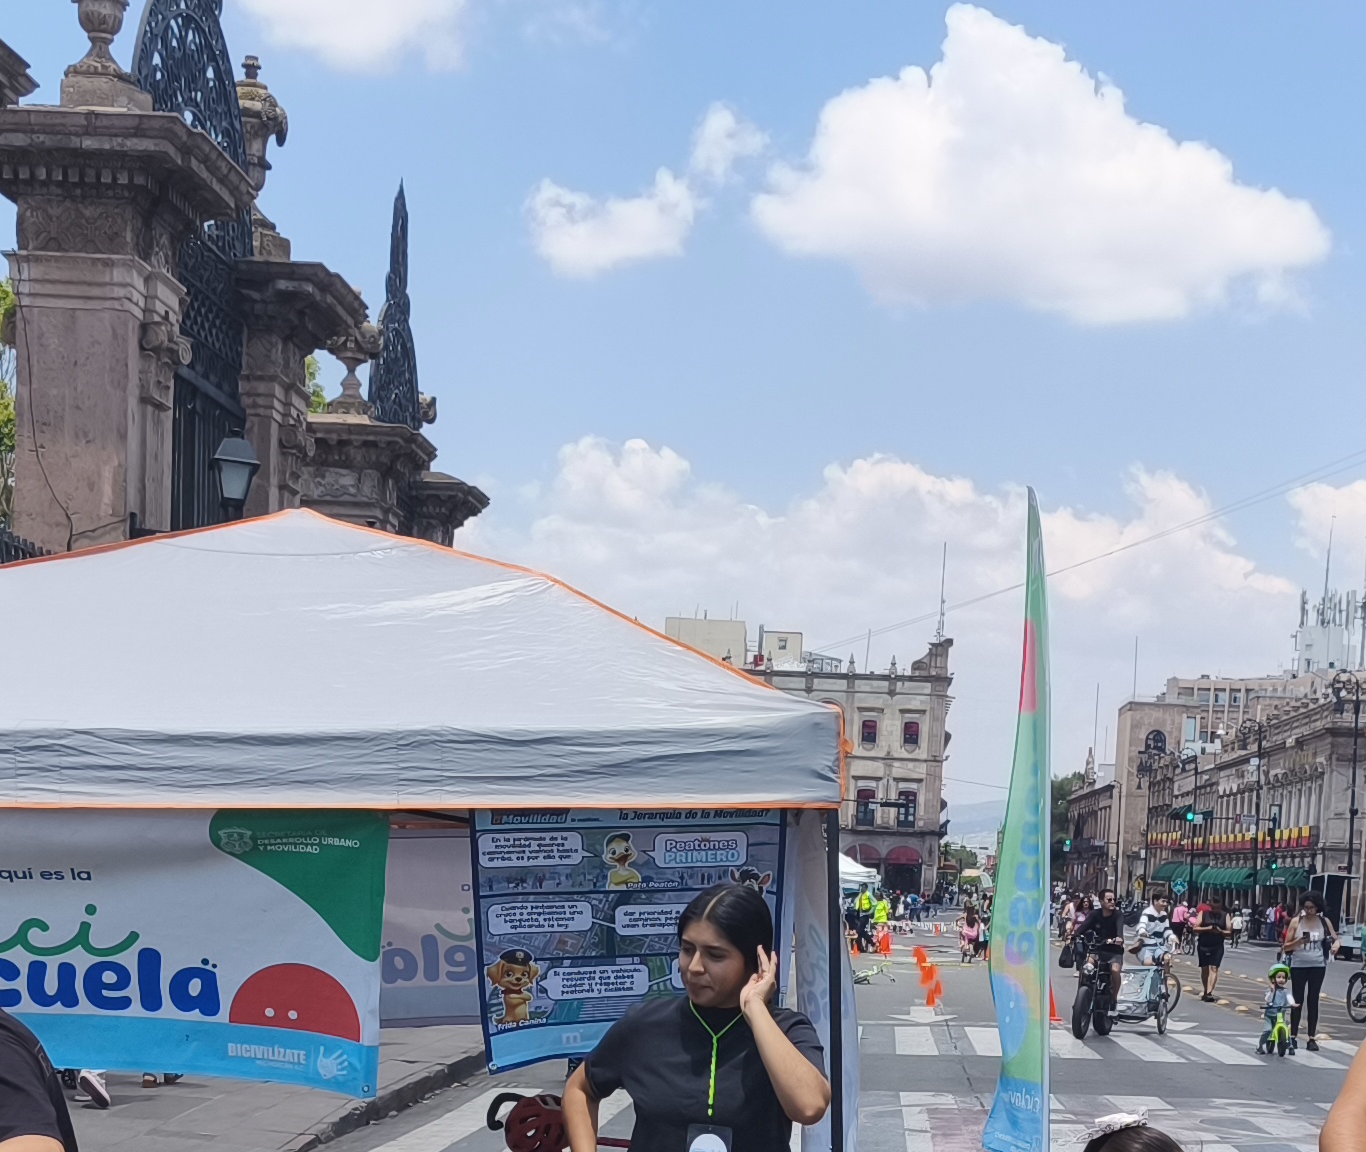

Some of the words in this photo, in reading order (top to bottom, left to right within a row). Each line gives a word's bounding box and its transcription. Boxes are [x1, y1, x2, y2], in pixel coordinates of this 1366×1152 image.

[501, 813, 566, 824] Movilidad
[685, 810, 698, 820] de
[700, 810, 711, 819] la
[257, 837, 319, 845] DESARROLLO
[321, 837, 360, 848] URBANO
[666, 839, 738, 851] Peatones
[267, 845, 320, 854] MOVILIDAD
[664, 850, 740, 864] PRIMERO
[40, 869, 65, 880] es
[70, 867, 92, 881] la
[627, 881, 647, 889] Pato
[497, 1021, 517, 1031] Frida
[519, 1017, 547, 1027] Canina
